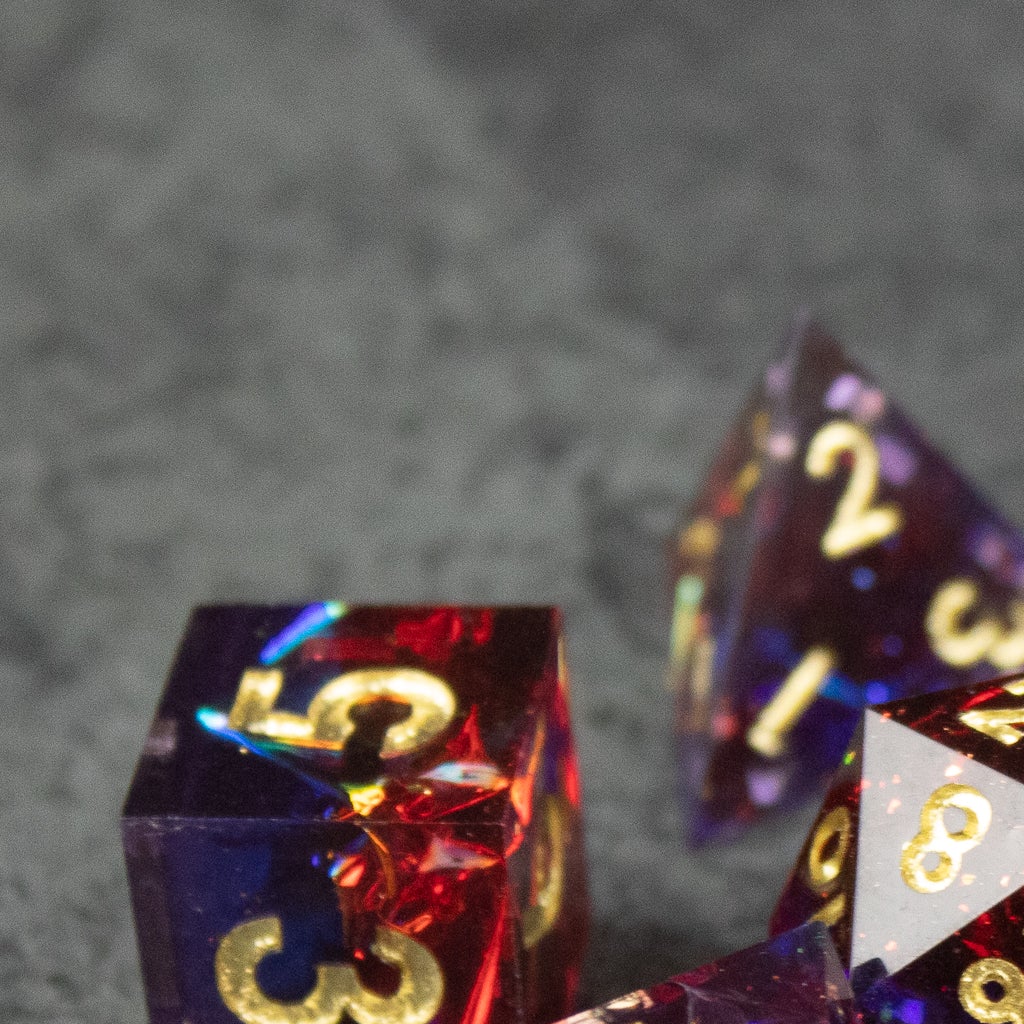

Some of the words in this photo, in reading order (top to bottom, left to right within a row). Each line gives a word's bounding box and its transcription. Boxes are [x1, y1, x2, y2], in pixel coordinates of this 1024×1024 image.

[806, 421, 900, 560] 2
[228, 667, 456, 761] 5
[747, 646, 833, 758] 1
[901, 782, 993, 894] 8
